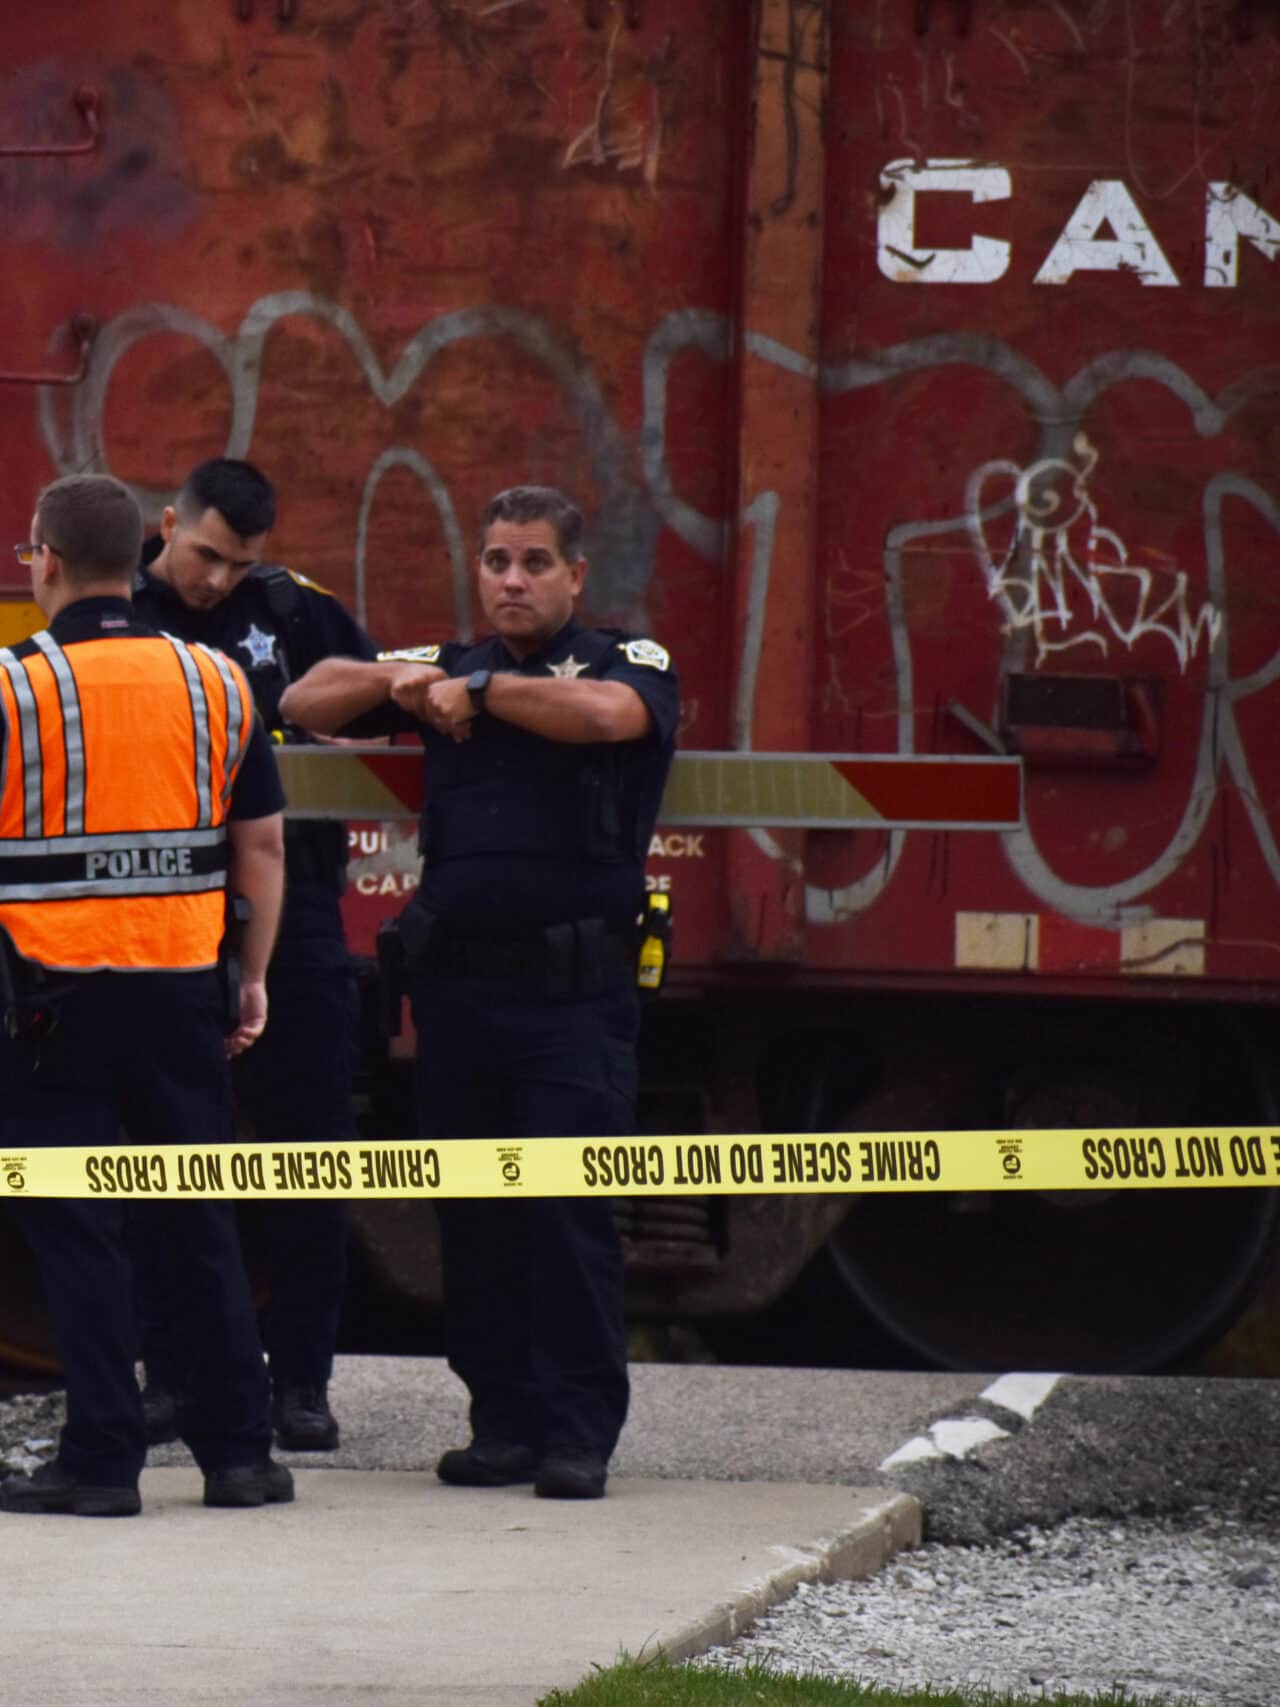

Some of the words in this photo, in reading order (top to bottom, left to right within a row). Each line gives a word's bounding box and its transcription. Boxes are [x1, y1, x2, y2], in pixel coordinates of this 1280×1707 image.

[86, 848, 193, 880] POLICE
[647, 833, 705, 858] ACK
[85, 1155, 168, 1192] CROSS
[177, 1154, 225, 1191] NOT
[230, 1153, 266, 1190] DO
[271, 1151, 353, 1190] SCENE
[359, 1149, 441, 1188] CRIME
[582, 1146, 665, 1186] CROSS
[673, 1145, 722, 1185] NOT
[729, 1144, 764, 1184] DO
[771, 1142, 852, 1182] SCENE
[859, 1140, 941, 1181] CRIME
[1082, 1137, 1166, 1180] CROSS
[1175, 1137, 1224, 1178] NOT
[1229, 1136, 1267, 1176] DO
